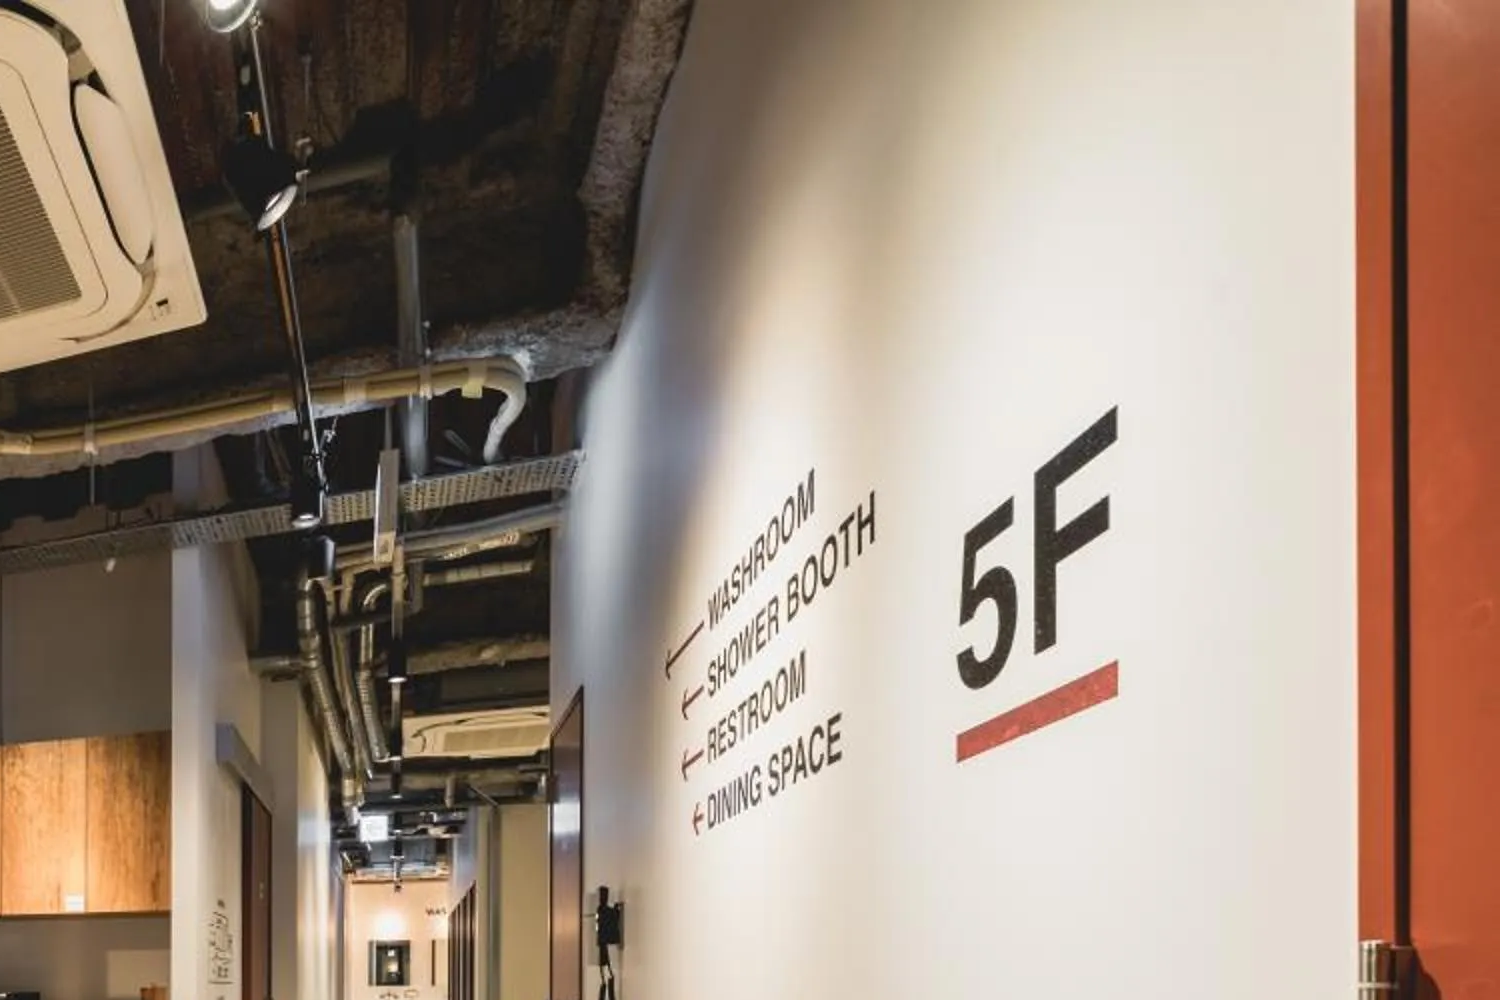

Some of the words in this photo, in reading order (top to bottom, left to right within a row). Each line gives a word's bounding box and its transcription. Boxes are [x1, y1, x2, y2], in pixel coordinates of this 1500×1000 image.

[707, 468, 816, 630] WASHROOM
[707, 611, 780, 698] SHOWER
[787, 491, 876, 623] BOOTH
[956, 405, 1118, 689] 5F
[707, 650, 806, 764] RESTROOM
[707, 760, 763, 830] DINING
[768, 712, 843, 797] SPACE
